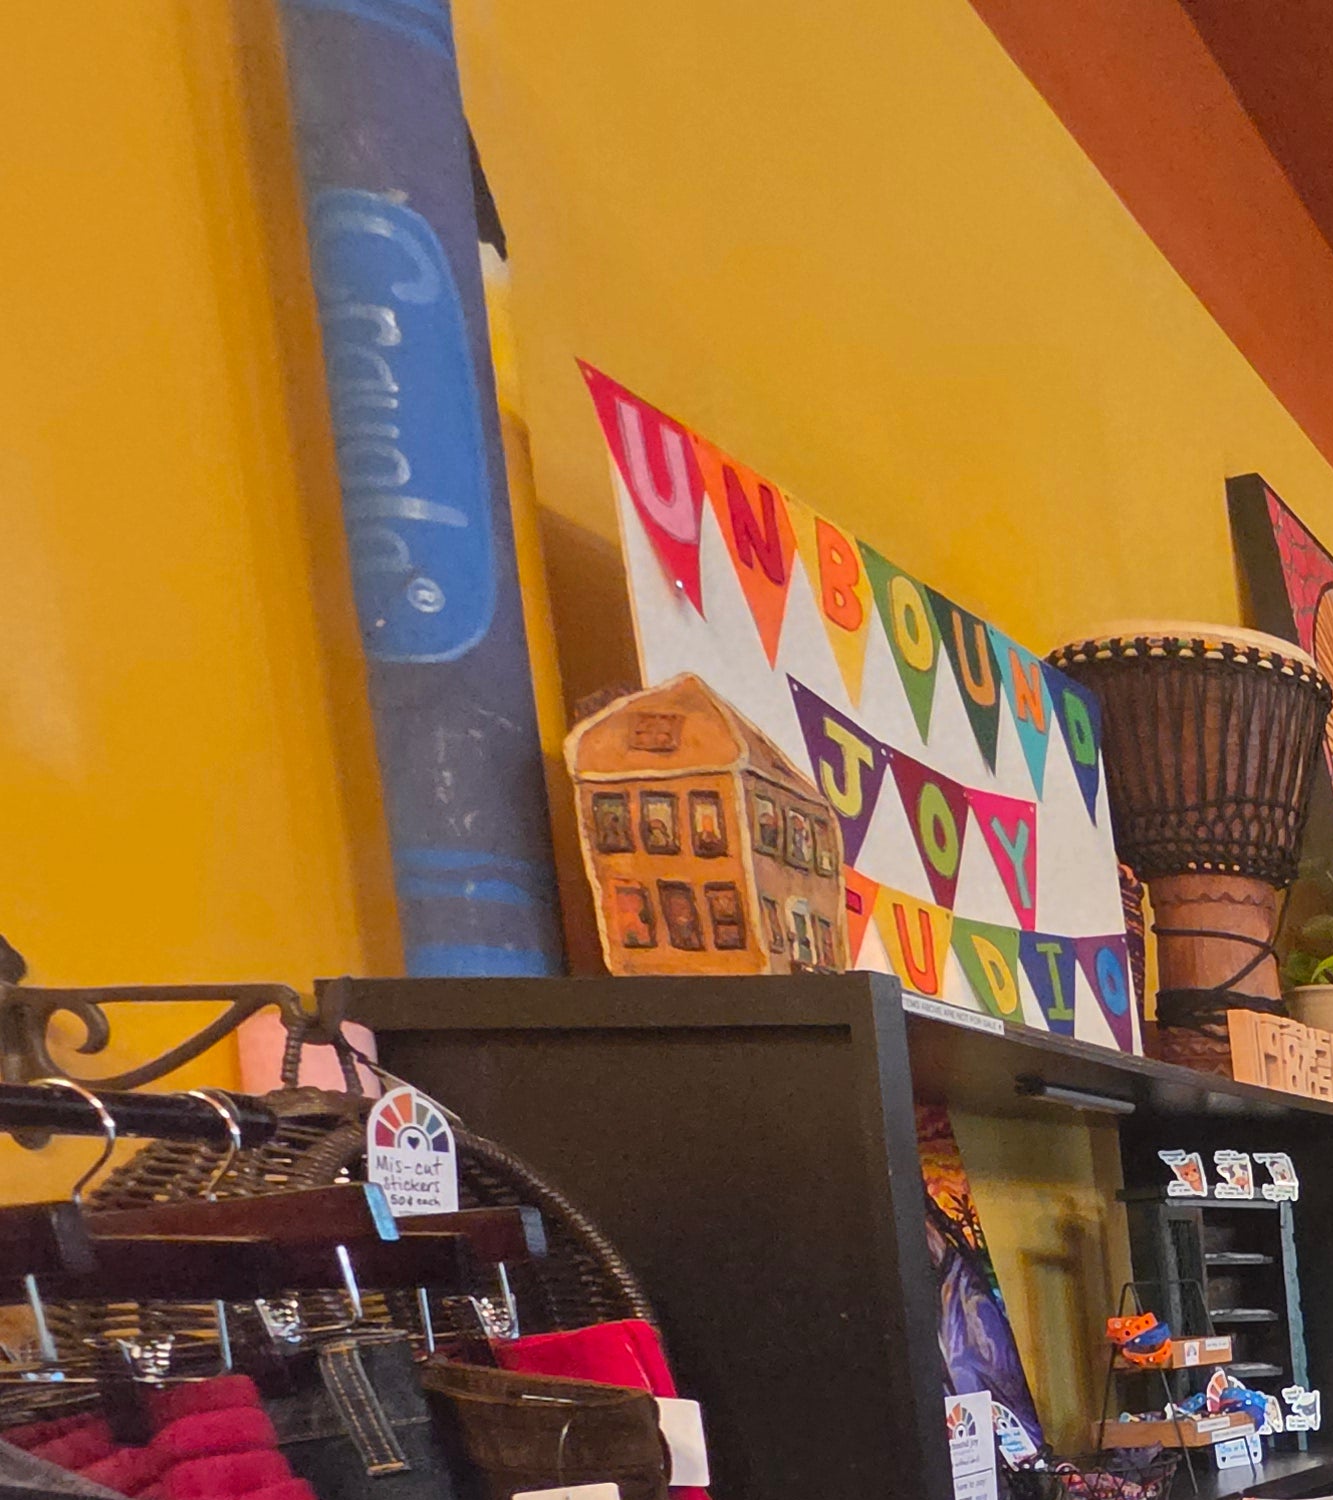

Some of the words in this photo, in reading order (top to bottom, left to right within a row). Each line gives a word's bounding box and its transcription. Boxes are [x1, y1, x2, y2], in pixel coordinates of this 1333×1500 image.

[616, 400, 1099, 770] UNBOUND
[818, 718, 1035, 910] JOY
[845, 887, 1128, 1022] UDIO
[376, 1154, 444, 1177] Mis-cut
[383, 1176, 441, 1194] stickers
[416, 1195, 441, 1207] each
